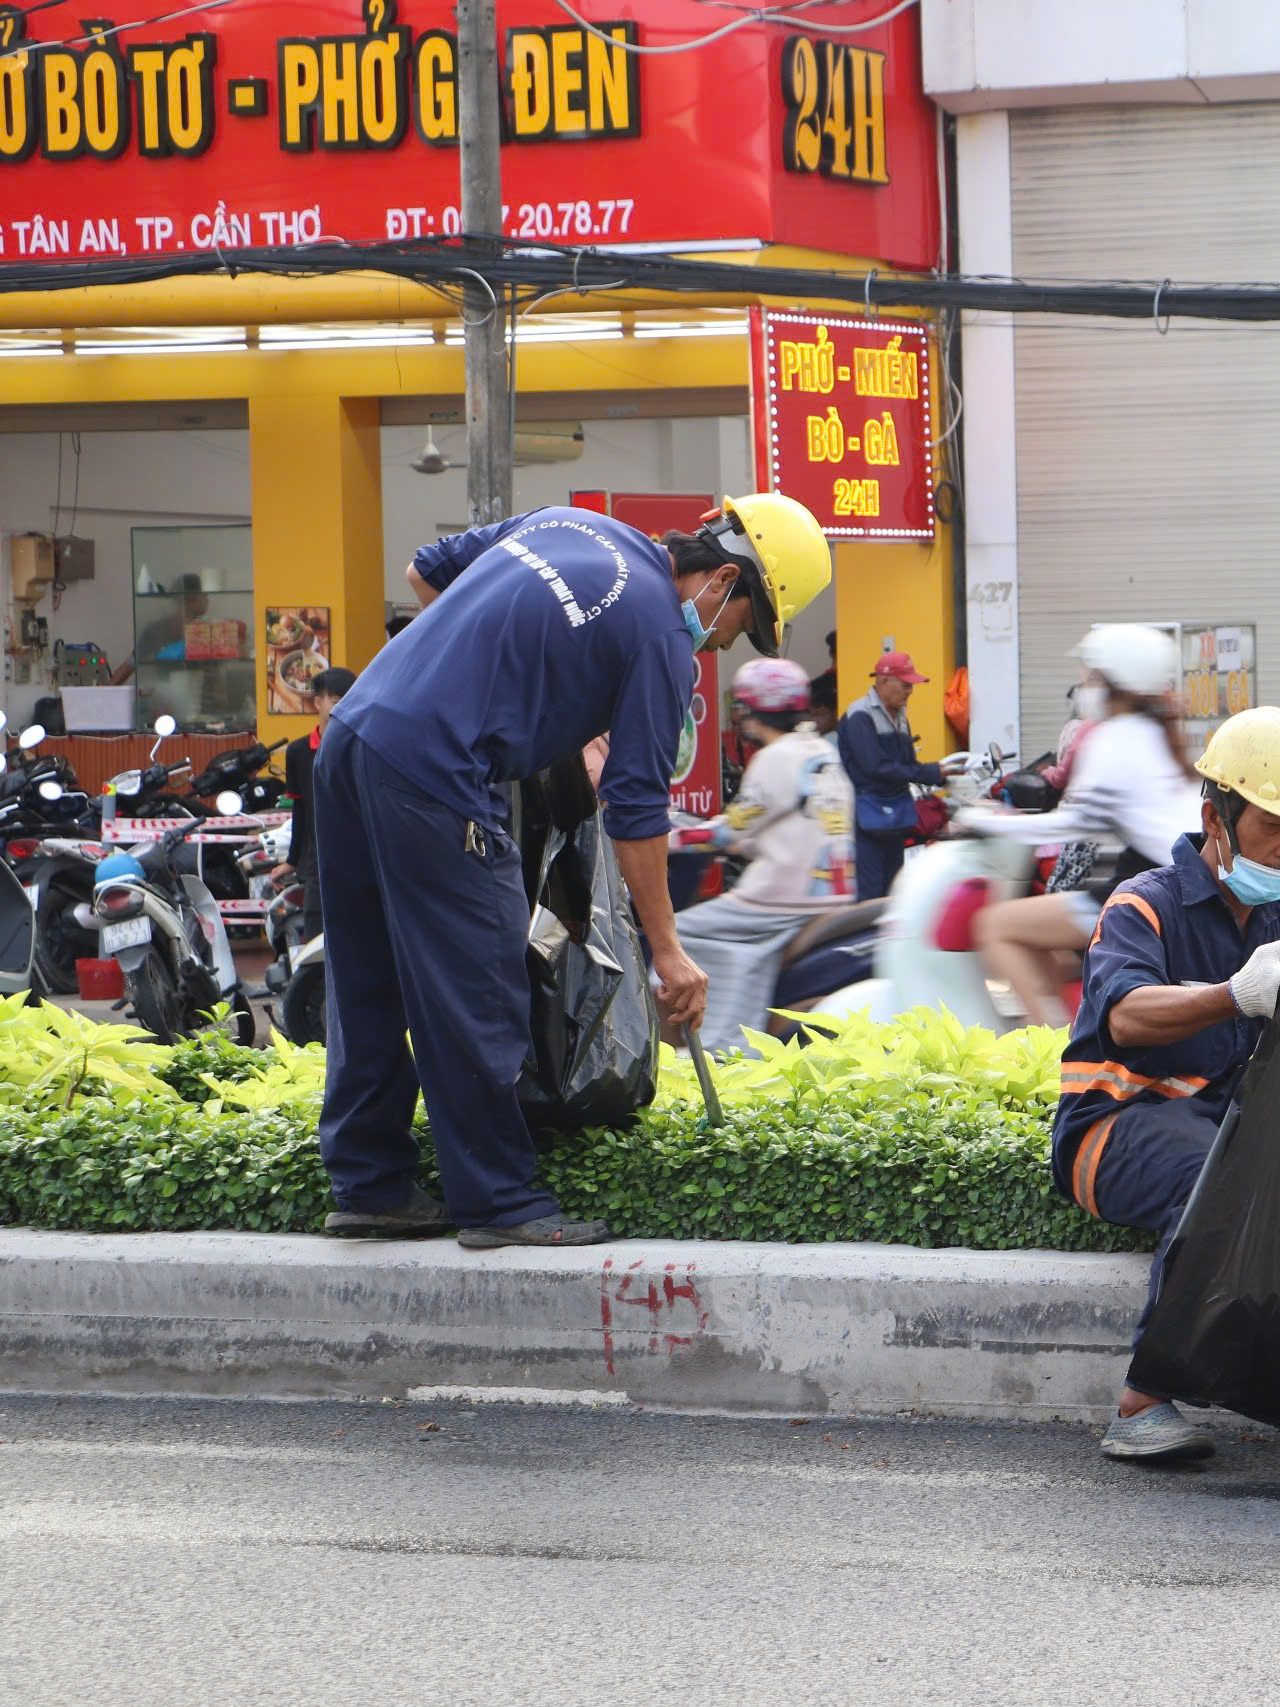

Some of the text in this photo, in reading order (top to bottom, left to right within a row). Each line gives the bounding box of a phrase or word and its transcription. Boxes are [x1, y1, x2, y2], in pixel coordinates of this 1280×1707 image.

[44, 27, 118, 152] BÒ
[134, 41, 204, 149] TƠ
[284, 0, 400, 143] PHỞ
[418, 36, 462, 140] G
[511, 28, 631, 134] ĐEN
[792, 36, 890, 184] 24H
[12, 214, 69, 253] TÂN
[79, 218, 127, 256] AN,
[136, 216, 184, 248] TP.
[191, 200, 250, 248] CẦN
[260, 204, 320, 245] THƠ
[386, 207, 435, 240] ĐT:
[780, 325, 835, 394] PHỞ
[854, 336, 919, 400] MIẾN
[807, 406, 844, 463] BÒ
[864, 411, 900, 466] GÀ
[833, 478, 880, 517] 24H
[586, 605, 602, 621] CT
[670, 785, 712, 812] HỈ TỪ
